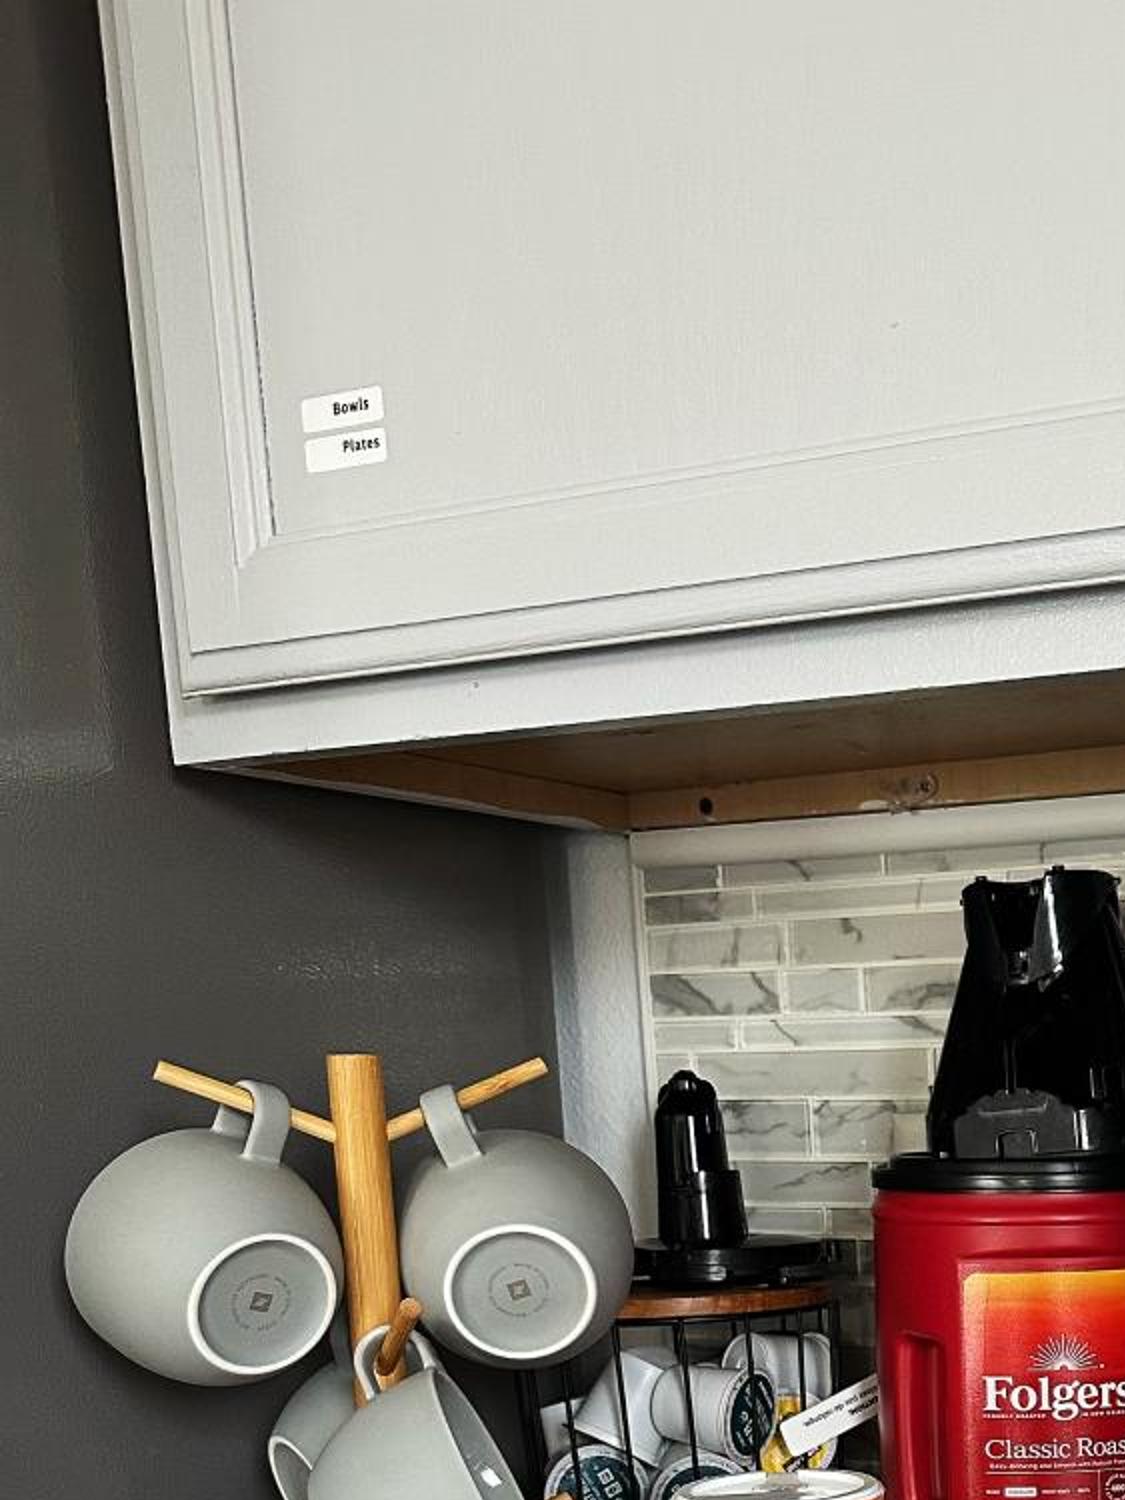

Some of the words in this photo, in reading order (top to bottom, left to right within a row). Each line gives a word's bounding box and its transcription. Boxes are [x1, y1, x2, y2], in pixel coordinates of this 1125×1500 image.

[332, 397, 369, 416] Bowls
[342, 437, 381, 453] Plates
[985, 1438, 1071, 1459] Classic
